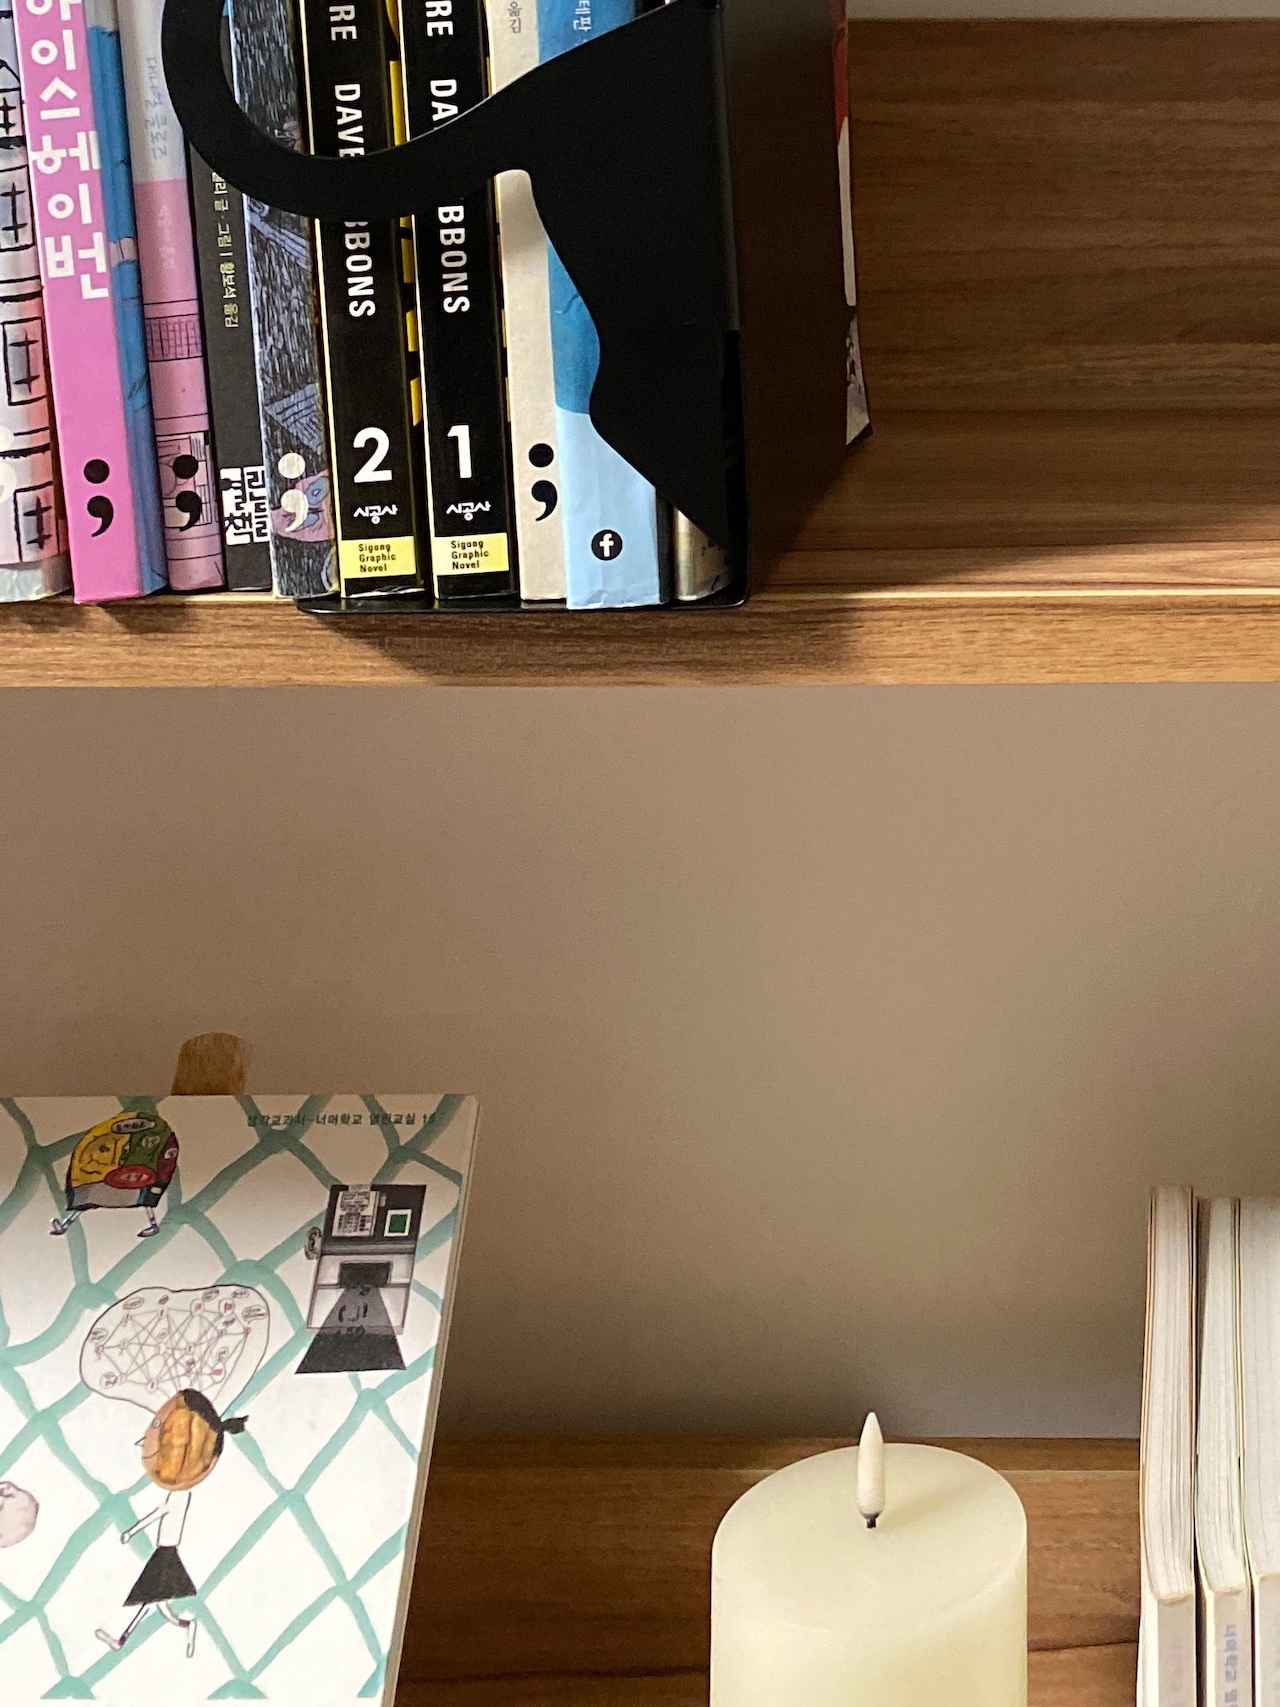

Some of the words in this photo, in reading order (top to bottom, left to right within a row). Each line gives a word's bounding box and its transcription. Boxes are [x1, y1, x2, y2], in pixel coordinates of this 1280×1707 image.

[430, 79, 459, 122] DA
[334, 82, 365, 159] DAVE
[343, 220, 376, 318] BONS
[437, 204, 471, 314] BBONS
[352, 426, 393, 484] 2
[446, 424, 473, 479] 1
[352, 503, 399, 525] 시공사
[445, 500, 491, 522] 시공사
[357, 541, 392, 554] Sigong
[450, 538, 485, 551] Sigong
[450, 549, 490, 561] Graphic
[357, 552, 397, 564] Graphic
[359, 563, 388, 573] Novel
[451, 559, 480, 570] Novel
